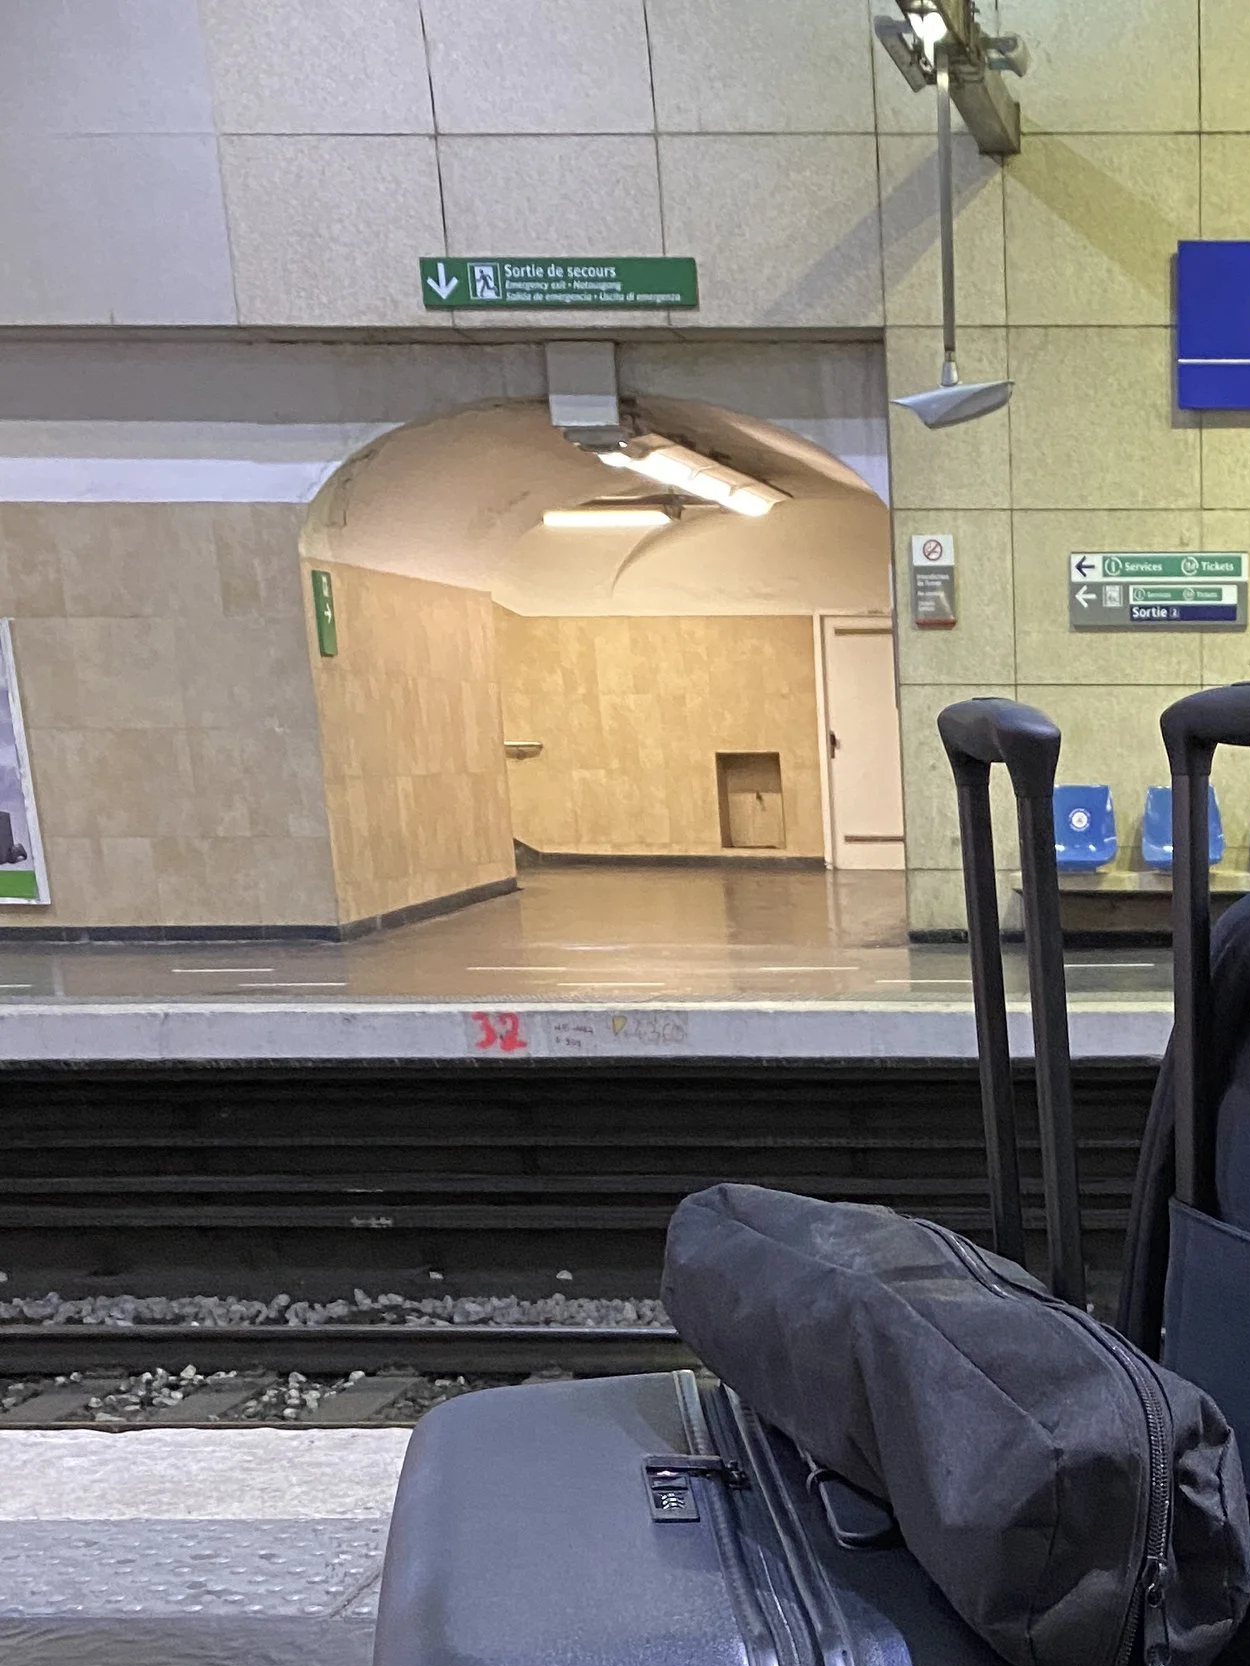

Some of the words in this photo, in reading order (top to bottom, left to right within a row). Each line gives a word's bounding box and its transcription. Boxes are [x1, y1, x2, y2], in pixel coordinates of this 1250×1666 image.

[504, 264, 543, 278] Sortie
[547, 264, 563, 277] de
[567, 266, 616, 278] secours
[505, 280, 548, 291] Emergency
[551, 280, 566, 289] exit
[1125, 562, 1163, 571] Services
[1202, 562, 1234, 571] Tickets
[1132, 607, 1168, 618] Sortie
[471, 1011, 527, 1050] 32
